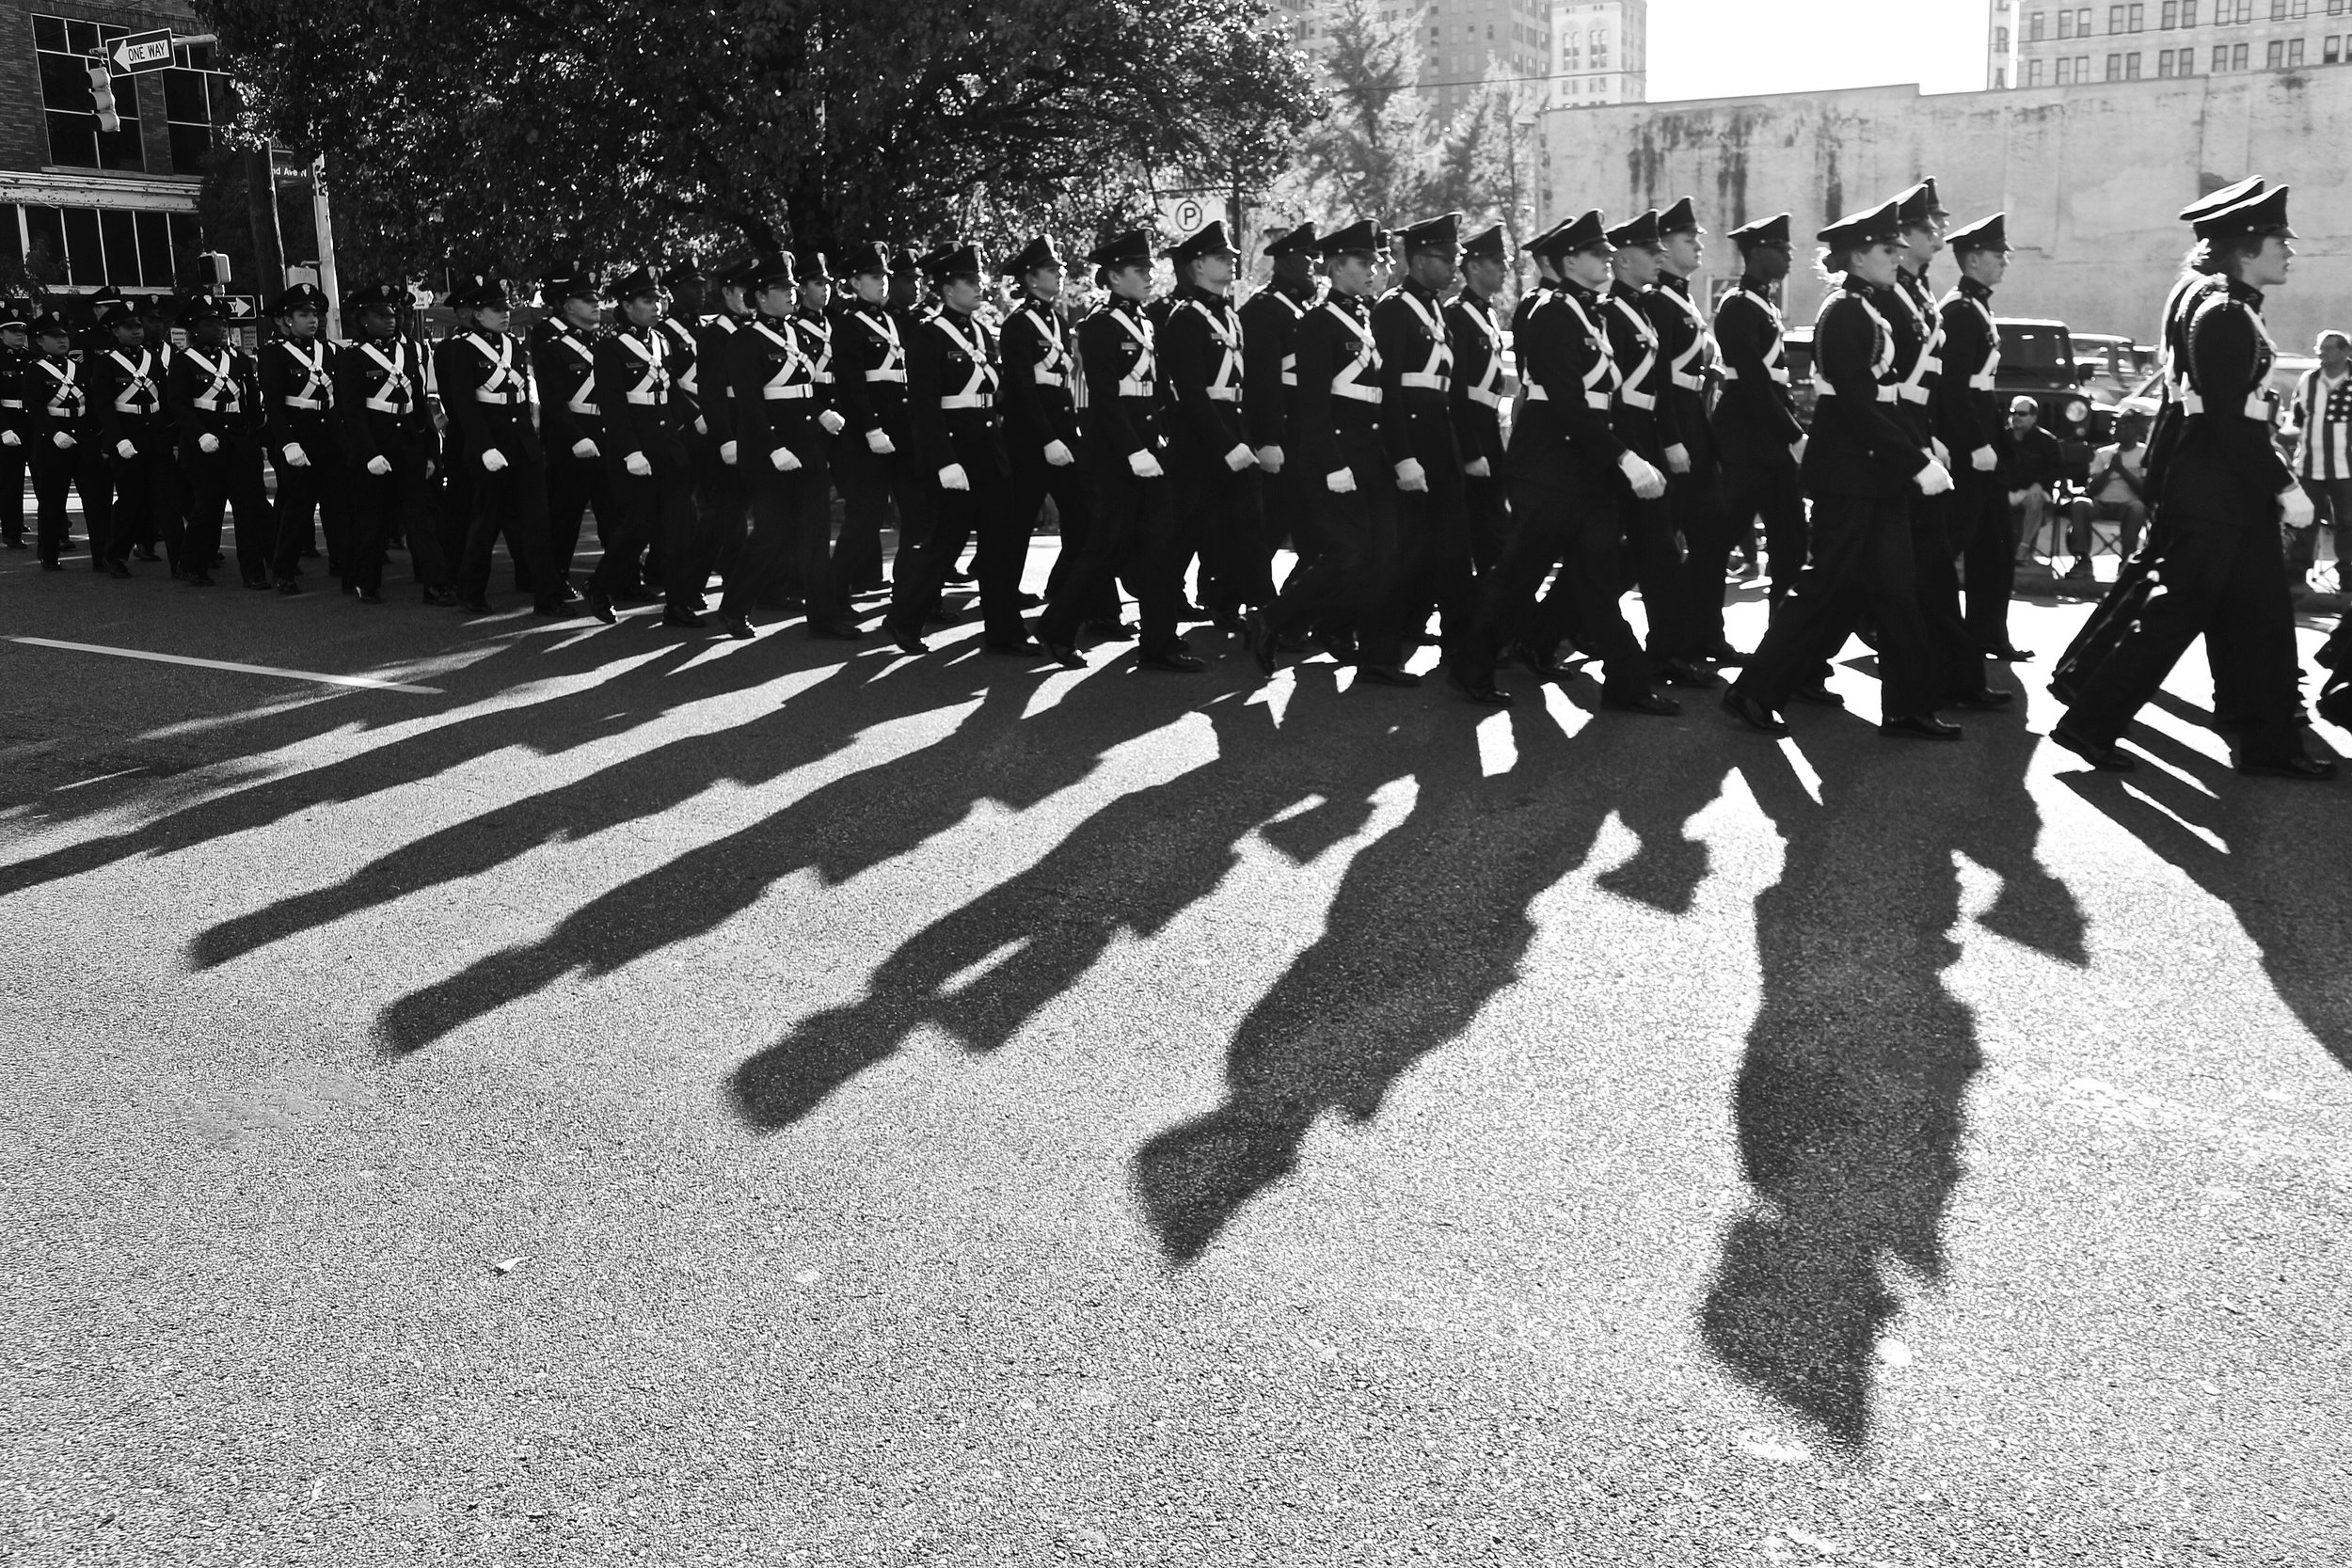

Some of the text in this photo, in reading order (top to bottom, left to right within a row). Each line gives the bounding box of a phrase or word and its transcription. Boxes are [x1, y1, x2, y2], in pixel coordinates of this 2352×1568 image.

[128, 42, 165, 62] ONE WAY
[283, 166, 298, 177] Ave
[1184, 207, 1197, 226] P
